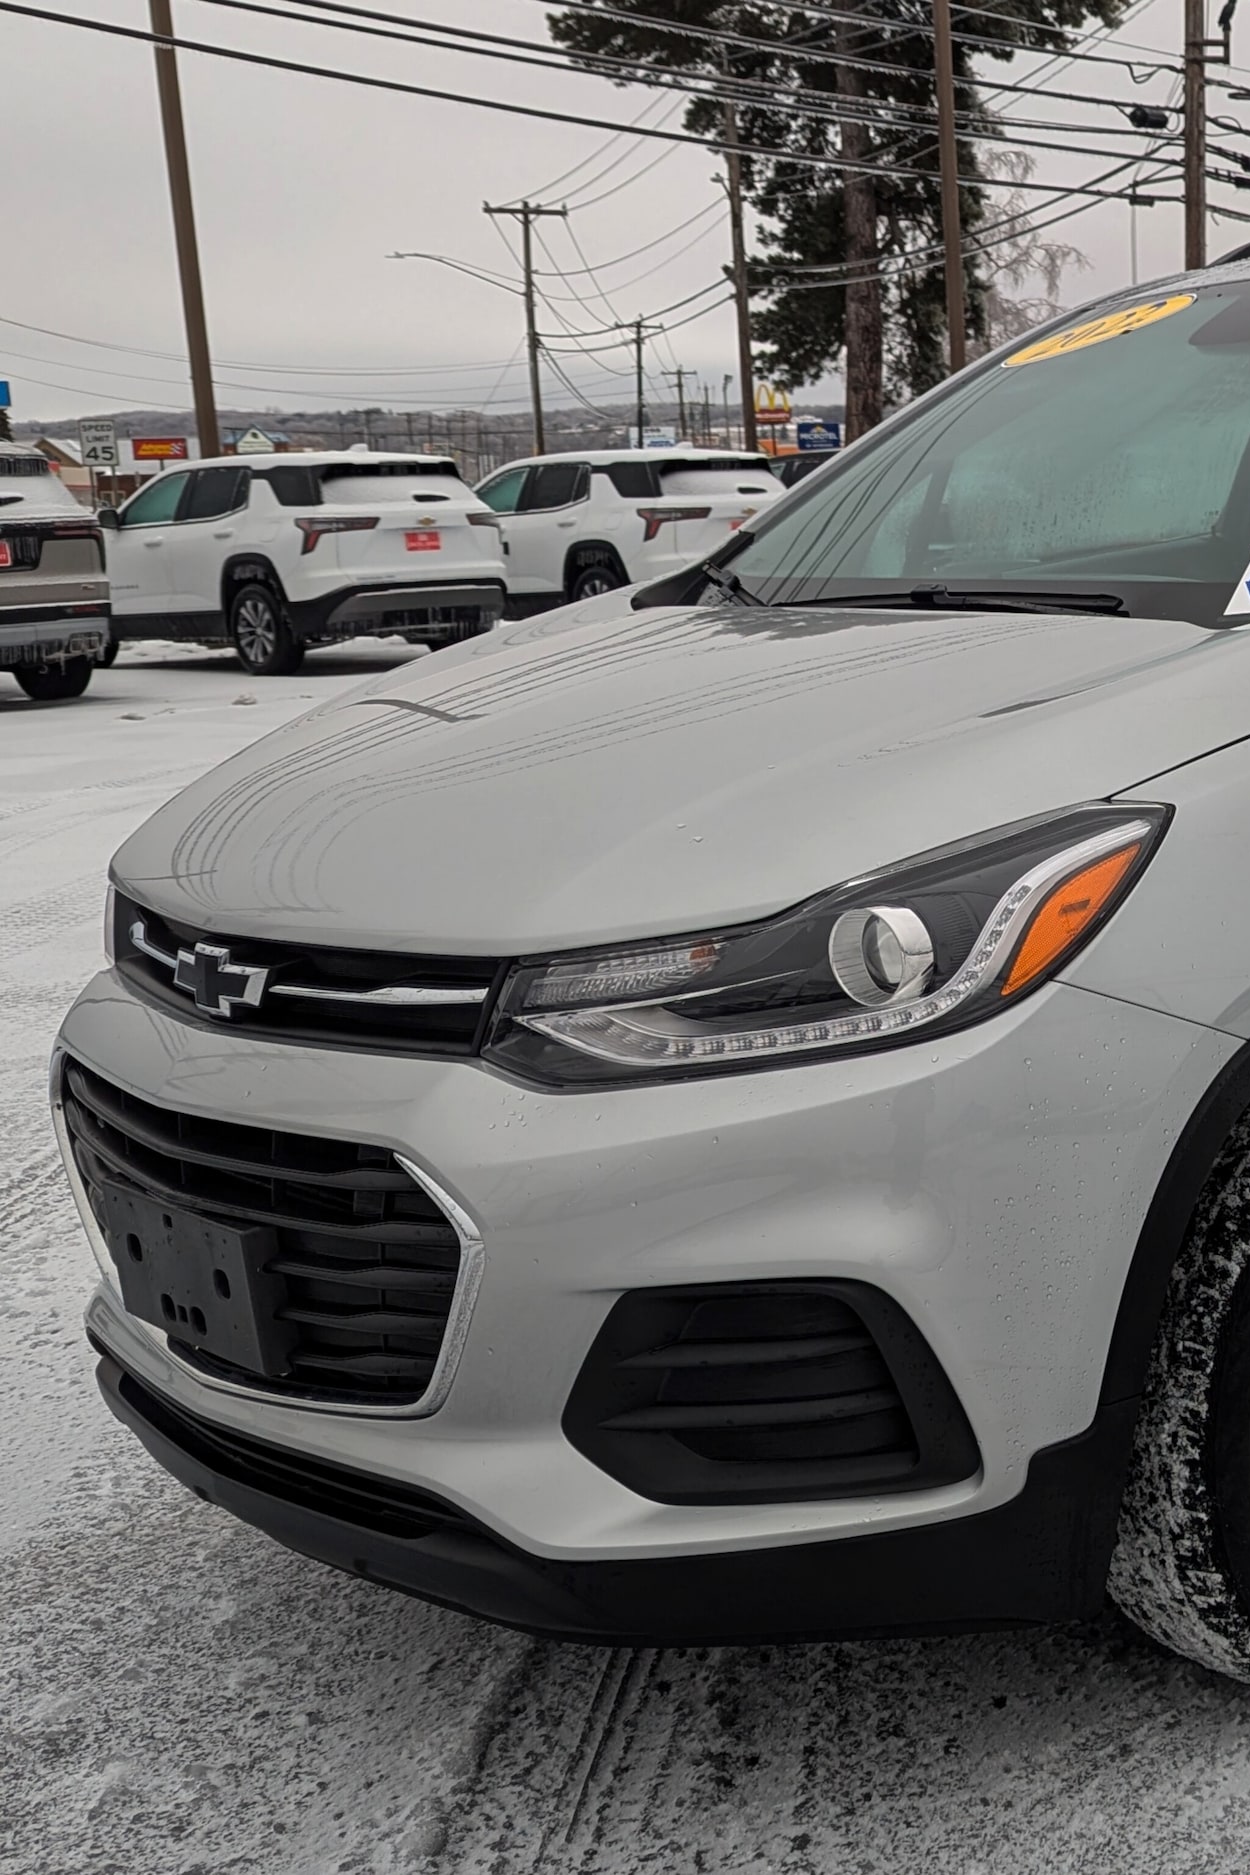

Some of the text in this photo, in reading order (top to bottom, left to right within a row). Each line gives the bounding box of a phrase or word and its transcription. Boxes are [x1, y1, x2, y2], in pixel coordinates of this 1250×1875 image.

[81, 424, 112, 432] SPEED
[86, 435, 110, 443] LIMIT
[86, 446, 114, 461] 45
